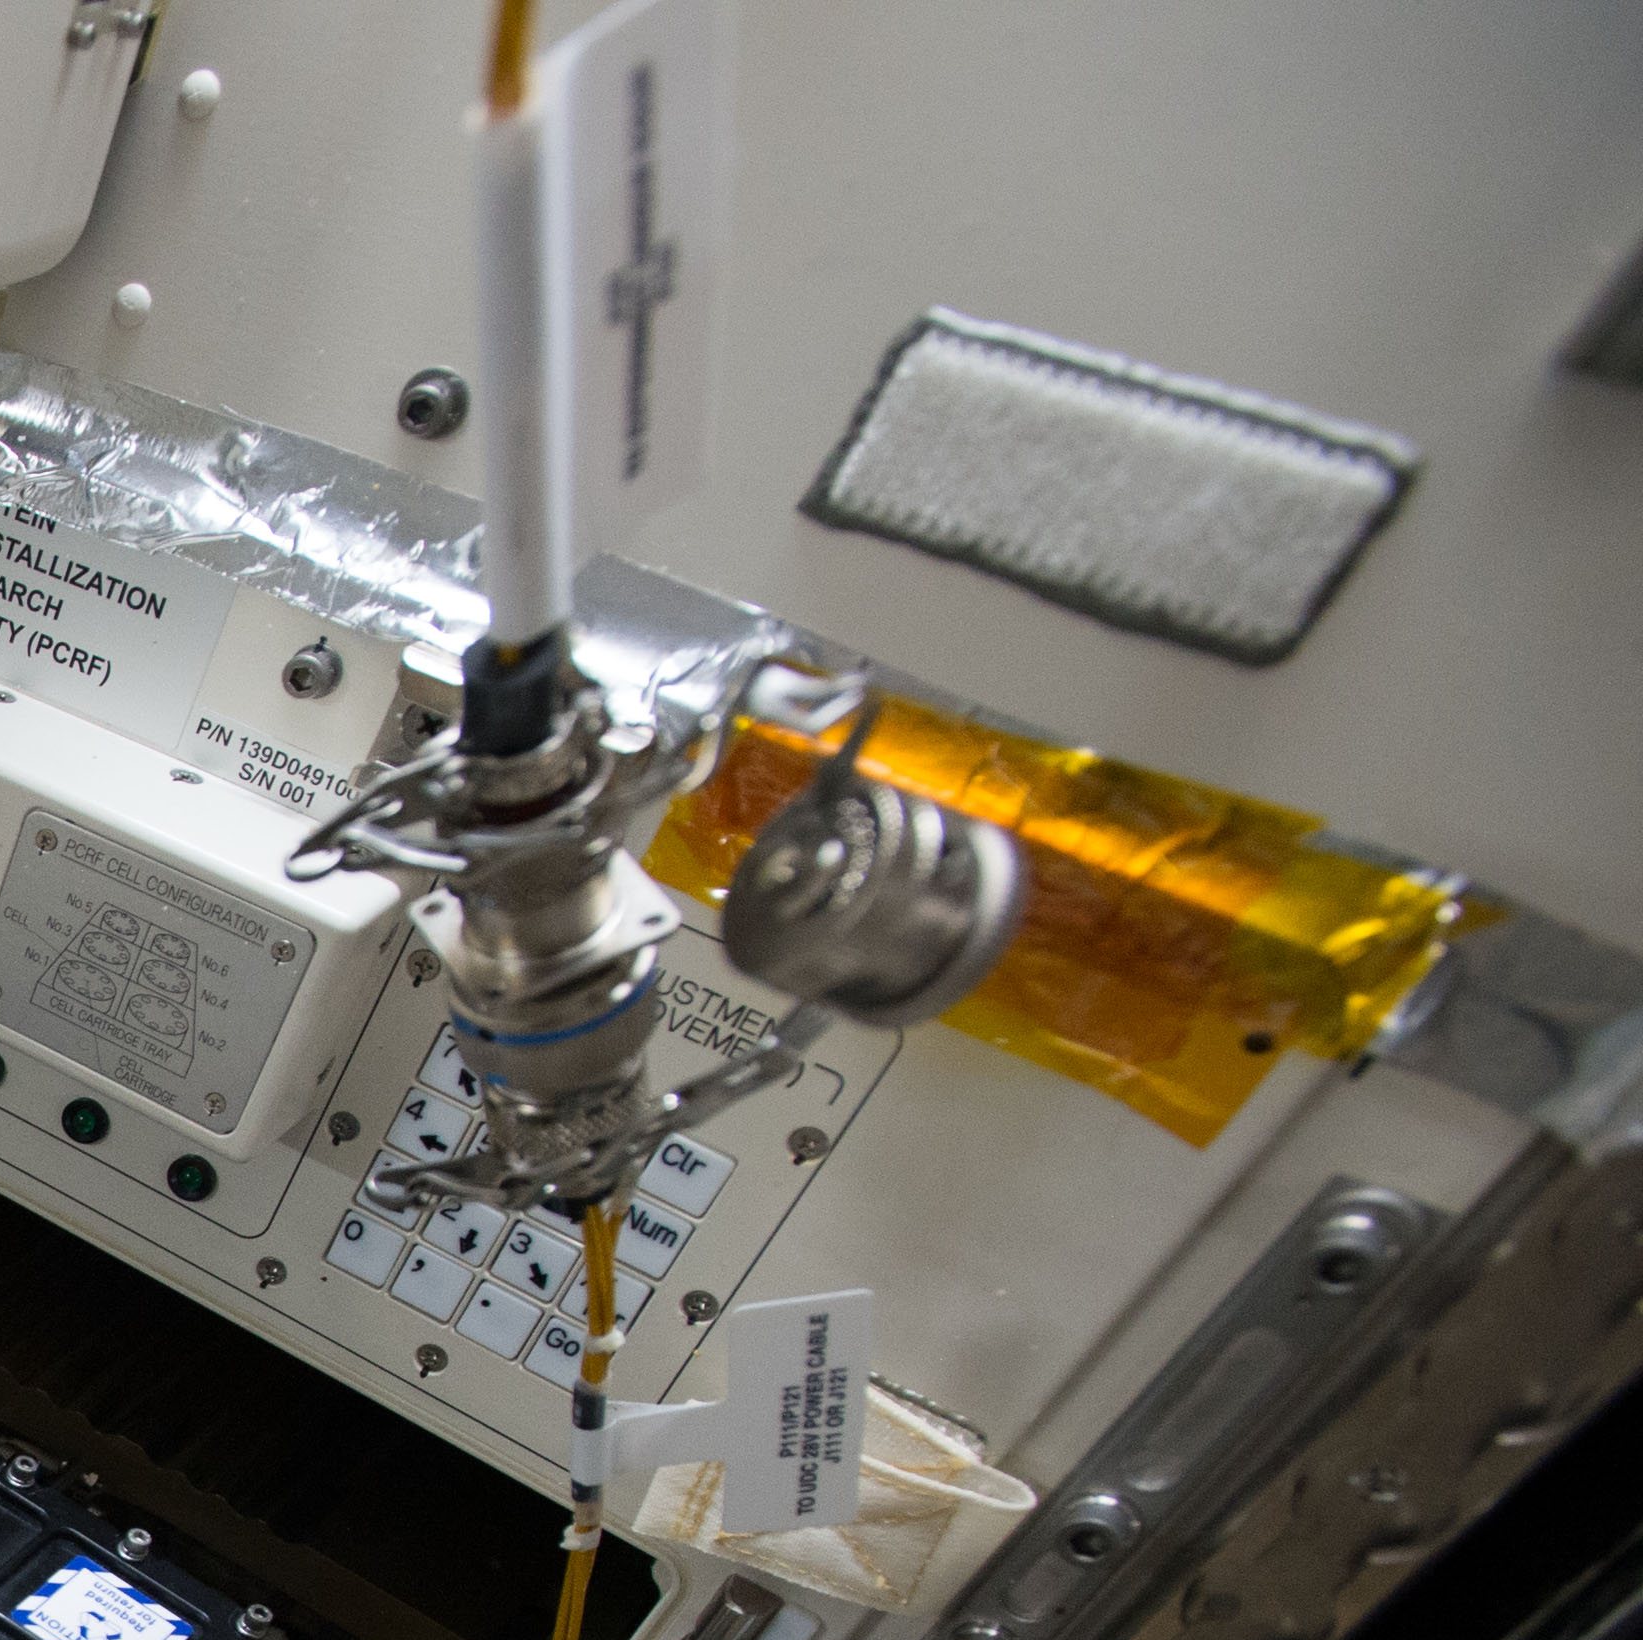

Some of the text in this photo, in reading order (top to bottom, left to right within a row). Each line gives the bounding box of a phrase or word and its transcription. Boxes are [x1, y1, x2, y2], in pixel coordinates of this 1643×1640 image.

[27, 630, 111, 686] (PCRF)
[196, 717, 234, 747] P/N
[238, 762, 316, 809] S/N 001
[65, 838, 268, 942] PCRF CELL CONFIGURATION
[66, 892, 93, 914] No.5
[4, 905, 29, 929] CELL
[46, 915, 73, 938] No.3
[24, 946, 50, 966] No.1
[201, 955, 230, 978] No.6
[200, 989, 229, 1011] No.4
[49, 996, 172, 1064] CELL CARTRIDGE TRAY
[198, 1029, 227, 1052] No.2
[118, 1054, 145, 1077] CELL
[115, 1067, 178, 1107] CARTRIDGE
[406, 1100, 426, 1121] 4
[660, 1142, 707, 1177] Clr
[440, 1202, 463, 1222] 2
[344, 1219, 364, 1242] 0
[627, 1204, 678, 1248] Num
[509, 1231, 533, 1255] 3
[545, 1327, 581, 1357] Go
[806, 1312, 829, 1369] CABLE
[803, 1372, 824, 1429] POWER
[826, 1404, 845, 1428] OR
[799, 1462, 819, 1494] UDC
[796, 1495, 816, 1516] TO
[84, 1590, 147, 1633] Required
[93, 1582, 157, 1627] for return
